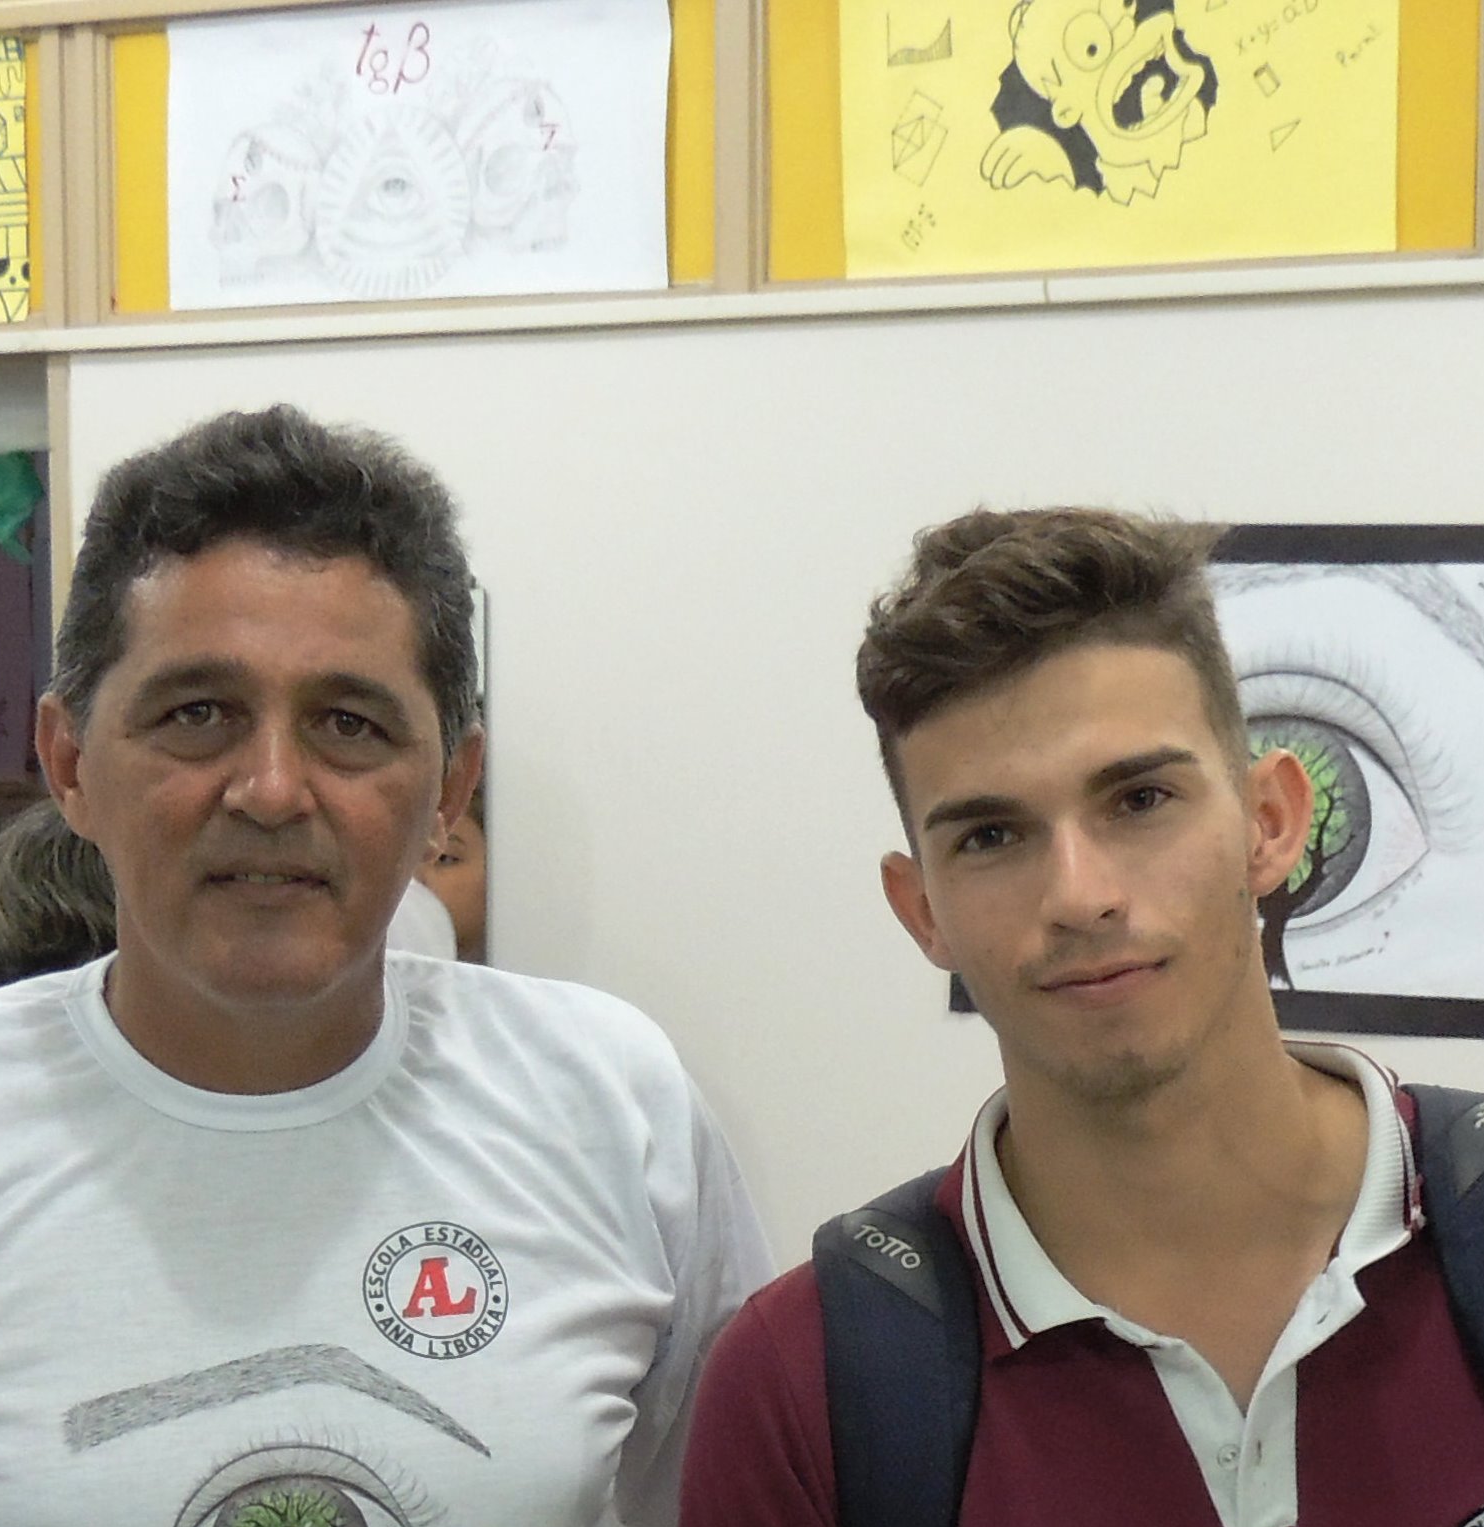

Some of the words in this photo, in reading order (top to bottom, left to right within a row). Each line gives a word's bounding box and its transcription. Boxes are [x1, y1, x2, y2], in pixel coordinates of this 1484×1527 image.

[367, 1234, 414, 1300] ESCOLA
[424, 1226, 503, 1291] ESTADUAL
[853, 1224, 921, 1270] TOTTO
[377, 1316, 416, 1349] ANA
